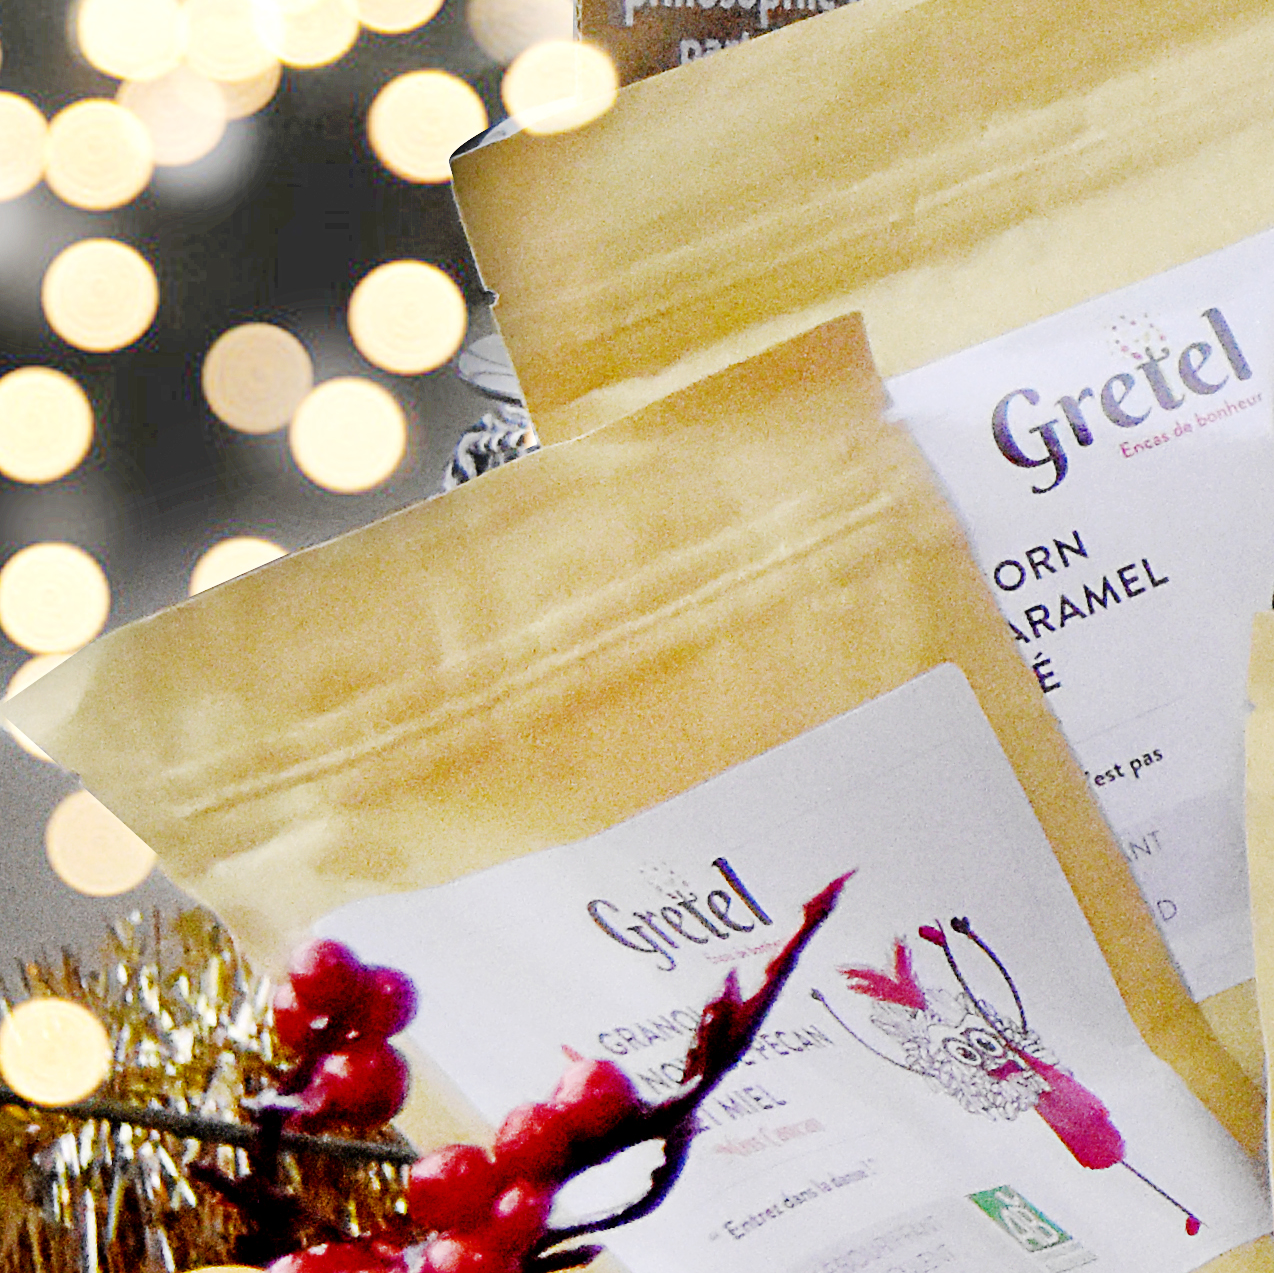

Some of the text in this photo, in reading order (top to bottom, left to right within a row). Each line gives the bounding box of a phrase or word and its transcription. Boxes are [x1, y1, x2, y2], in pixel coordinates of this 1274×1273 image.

[991, 307, 1253, 495] Gretel
[1119, 392, 1264, 459] Encas de bonheur
[992, 530, 1090, 592] ORN
[1129, 748, 1165, 780] pas
[587, 857, 774, 972] Gretel
[717, 1085, 788, 1122] MIEL
